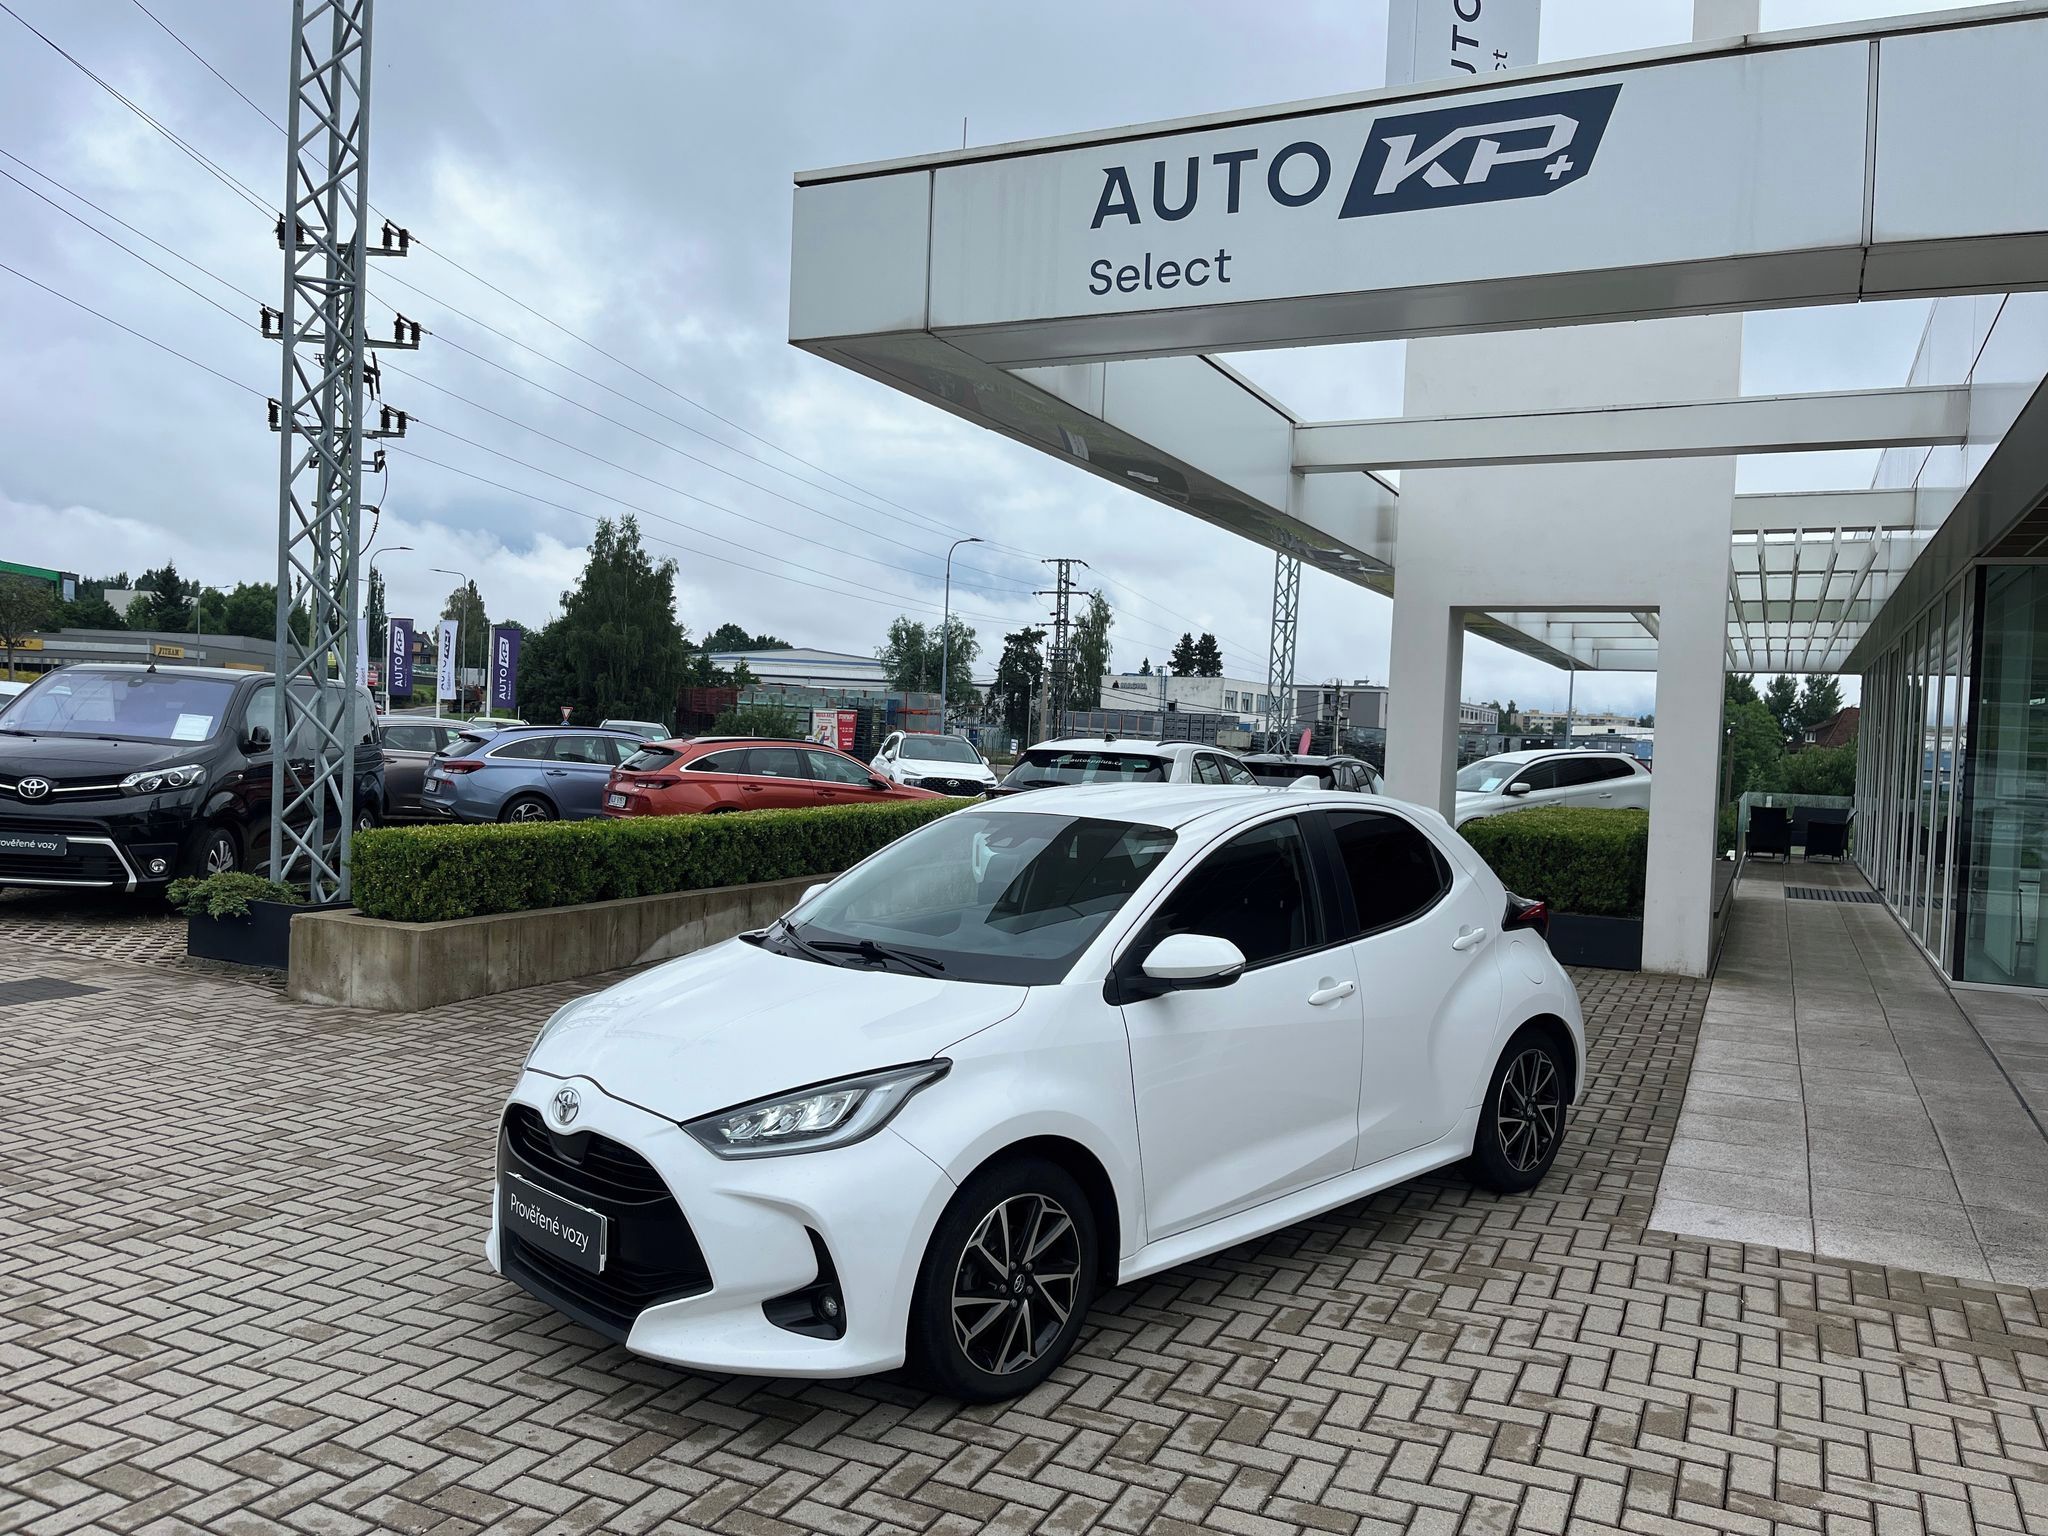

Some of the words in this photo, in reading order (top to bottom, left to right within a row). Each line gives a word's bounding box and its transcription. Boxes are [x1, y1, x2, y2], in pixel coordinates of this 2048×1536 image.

[1089, 140, 1332, 230] AUTO
[1088, 248, 1232, 296] Select
[394, 656, 403, 688] AUTO
[499, 668, 507, 700] AUTO
[37, 842, 58, 851] vozy
[510, 1192, 560, 1236] Prověřené
[561, 1224, 589, 1253] vozy
